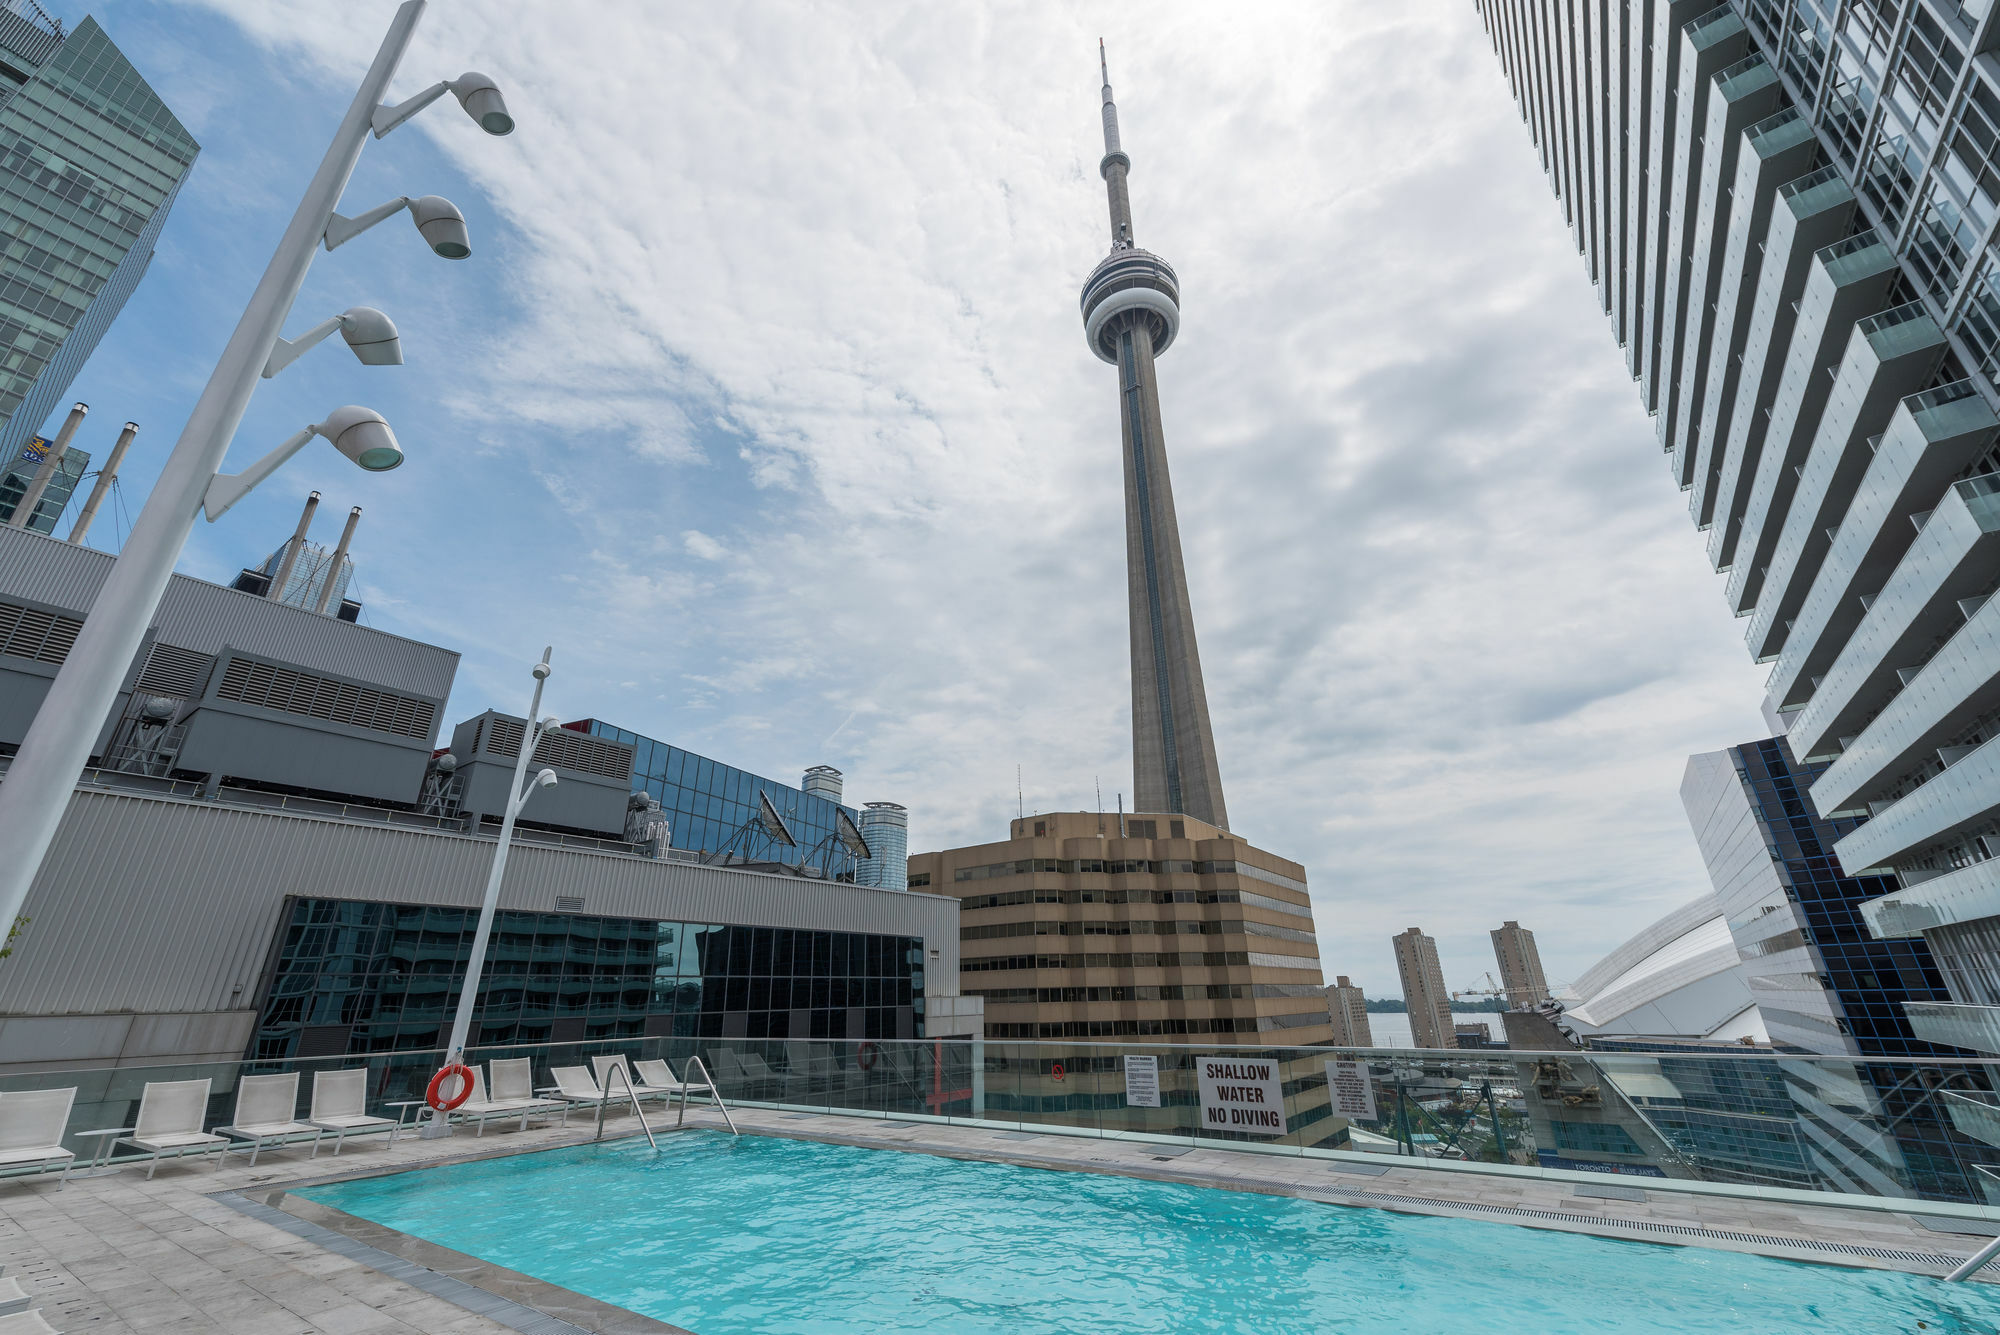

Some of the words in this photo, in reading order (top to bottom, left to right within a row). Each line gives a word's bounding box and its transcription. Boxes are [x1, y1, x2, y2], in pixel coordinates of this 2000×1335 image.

[1206, 1063, 1270, 1081] SHALLOW
[1216, 1085, 1265, 1103] WATER
[1208, 1106, 1227, 1124] NO
[1231, 1108, 1280, 1128] DIVING
[1575, 1164, 1611, 1173] TORONTO
[1619, 1167, 1637, 1175] BLUE
